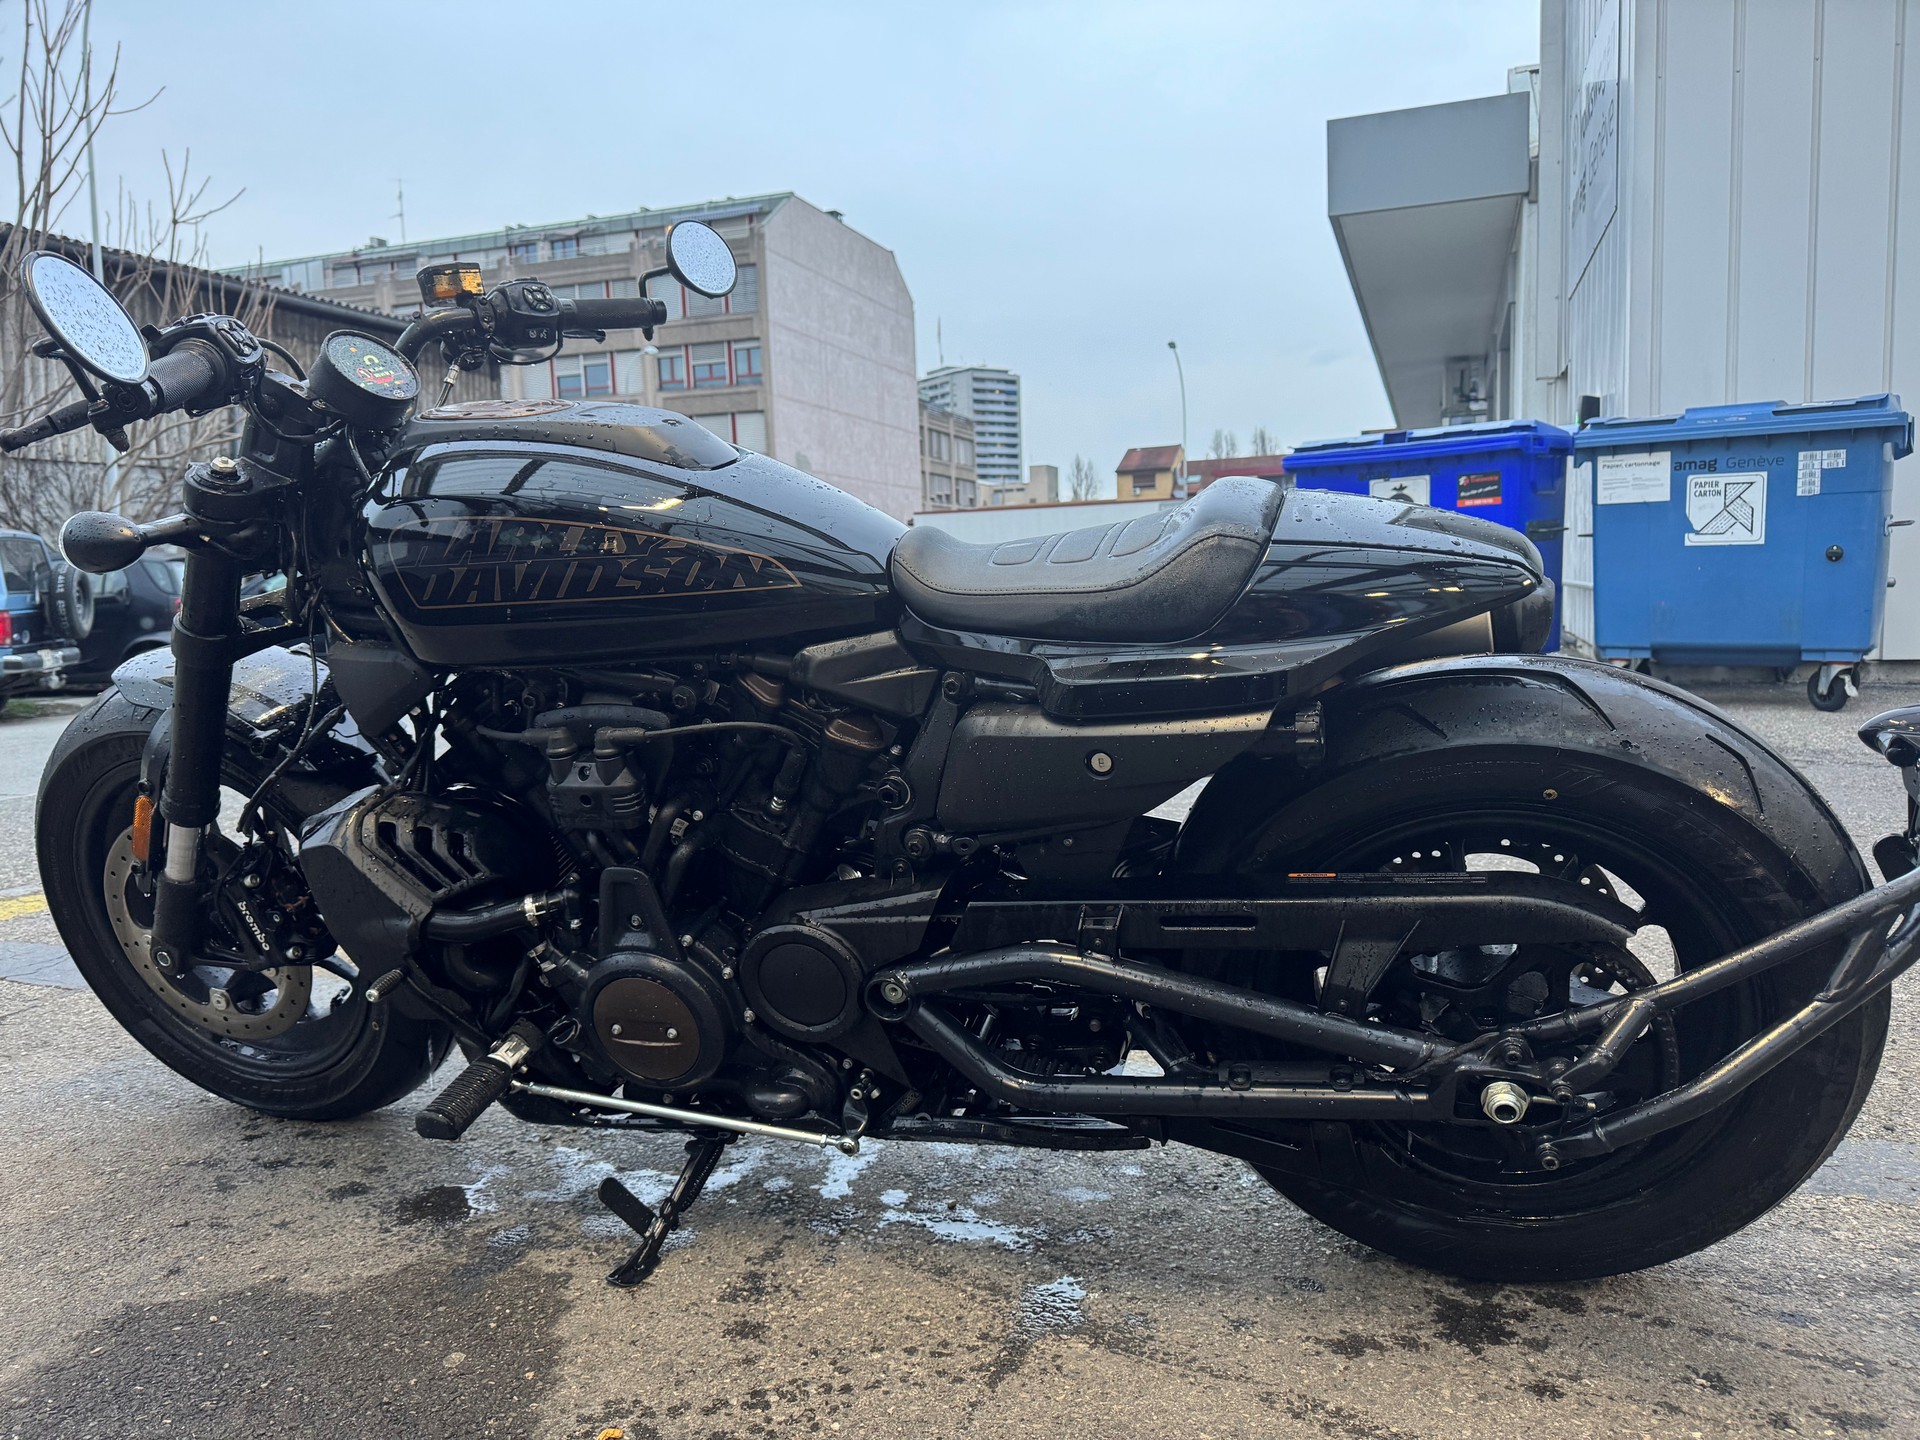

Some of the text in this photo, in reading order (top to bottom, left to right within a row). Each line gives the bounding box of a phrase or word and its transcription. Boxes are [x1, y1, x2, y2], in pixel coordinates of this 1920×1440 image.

[1624, 460, 1661, 468] cartonnage
[1674, 455, 1785, 472] amag Genève
[1694, 480, 1720, 489] PAPIER
[1694, 489, 1722, 498] CARTON
[402, 555, 788, 603] DAVIDSON
[236, 900, 271, 951] brembo
